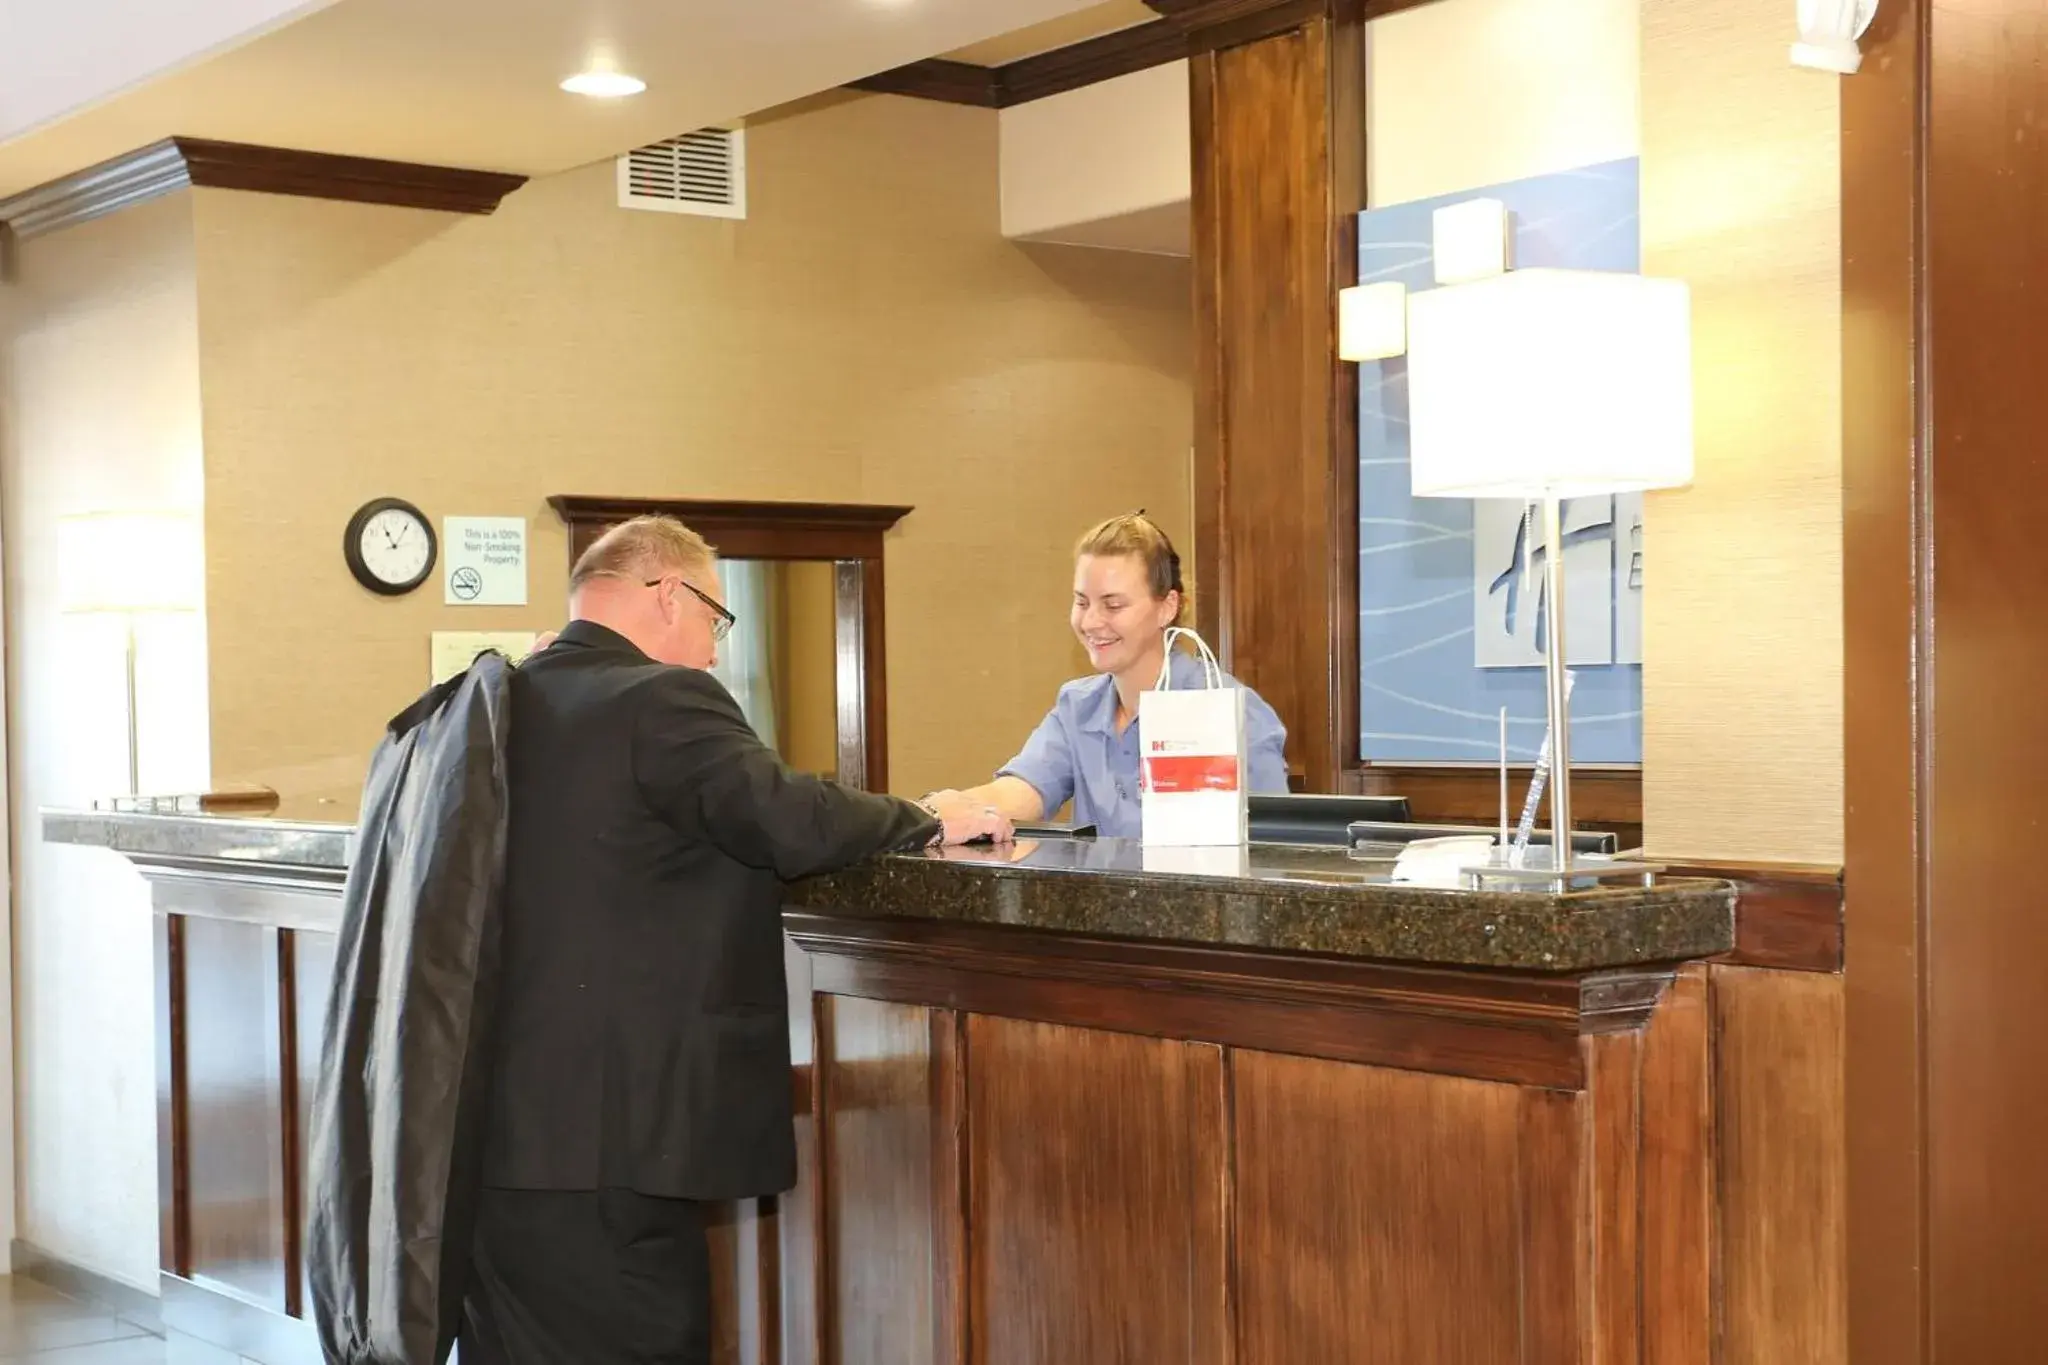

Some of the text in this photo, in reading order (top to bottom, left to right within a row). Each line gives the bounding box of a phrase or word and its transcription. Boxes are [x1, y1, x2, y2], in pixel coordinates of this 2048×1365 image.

[465, 528, 481, 539] This
[483, 530, 490, 539] is
[499, 529, 521, 540] 100%
[464, 541, 521, 555] Non-Smoking
